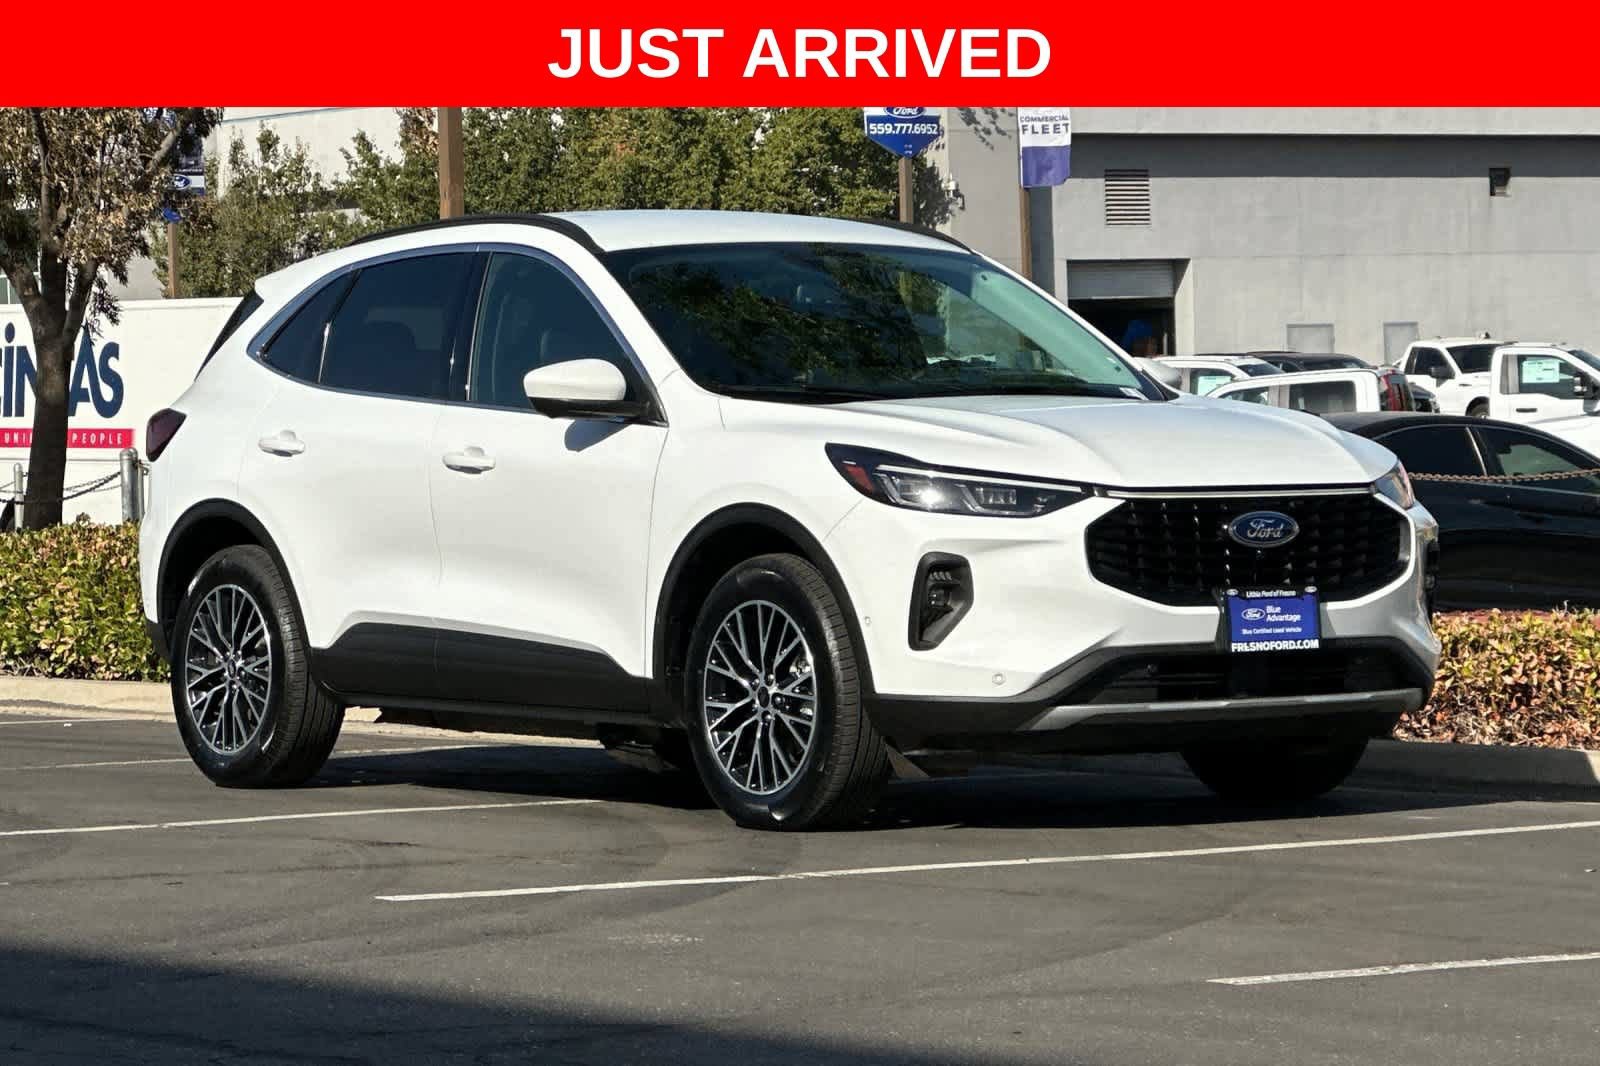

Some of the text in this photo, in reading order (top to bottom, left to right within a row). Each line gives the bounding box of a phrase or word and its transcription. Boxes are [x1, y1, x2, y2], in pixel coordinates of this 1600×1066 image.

[1020, 115, 1069, 123] COMMERCIAL
[869, 122, 938, 135] 559.777.6952
[1021, 123, 1069, 135] FLEET
[72, 432, 123, 445] PEOPLE
[1247, 518, 1284, 538] Ford
[1266, 605, 1281, 614] Blue
[1266, 614, 1302, 622] Advantage
[1231, 638, 1320, 653] FRESNOFORD.COM
